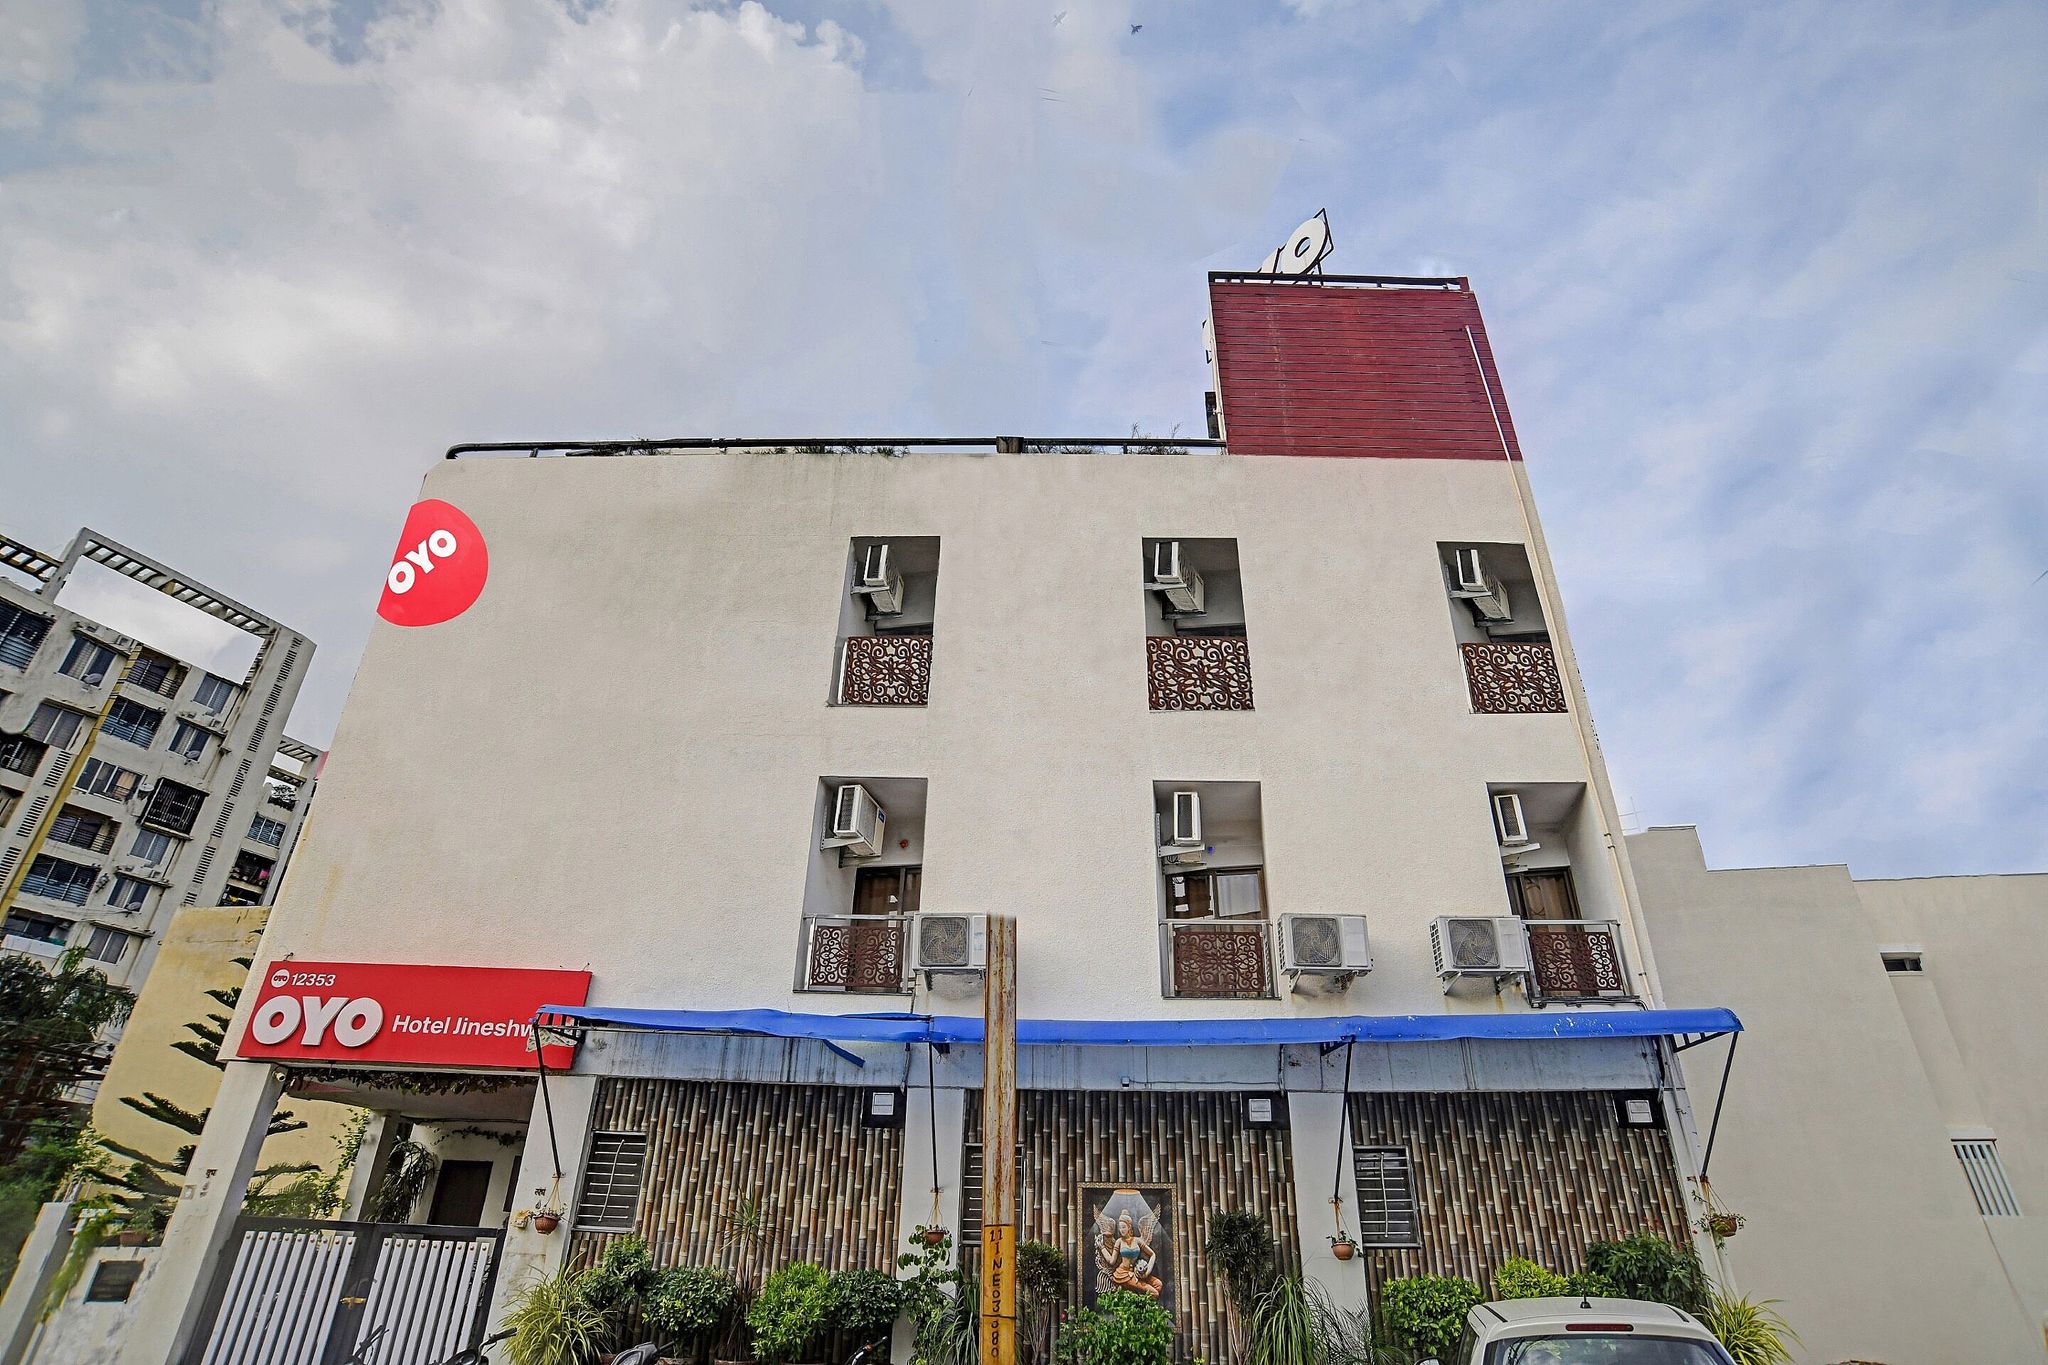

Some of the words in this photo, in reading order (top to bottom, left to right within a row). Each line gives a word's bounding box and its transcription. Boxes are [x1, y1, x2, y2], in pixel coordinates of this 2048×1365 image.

[388, 529, 457, 594] OYO
[291, 973, 336, 987] 12353
[252, 995, 383, 1048] OYO
[392, 1014, 449, 1035] Hotel
[452, 1017, 533, 1038] Jineshw
